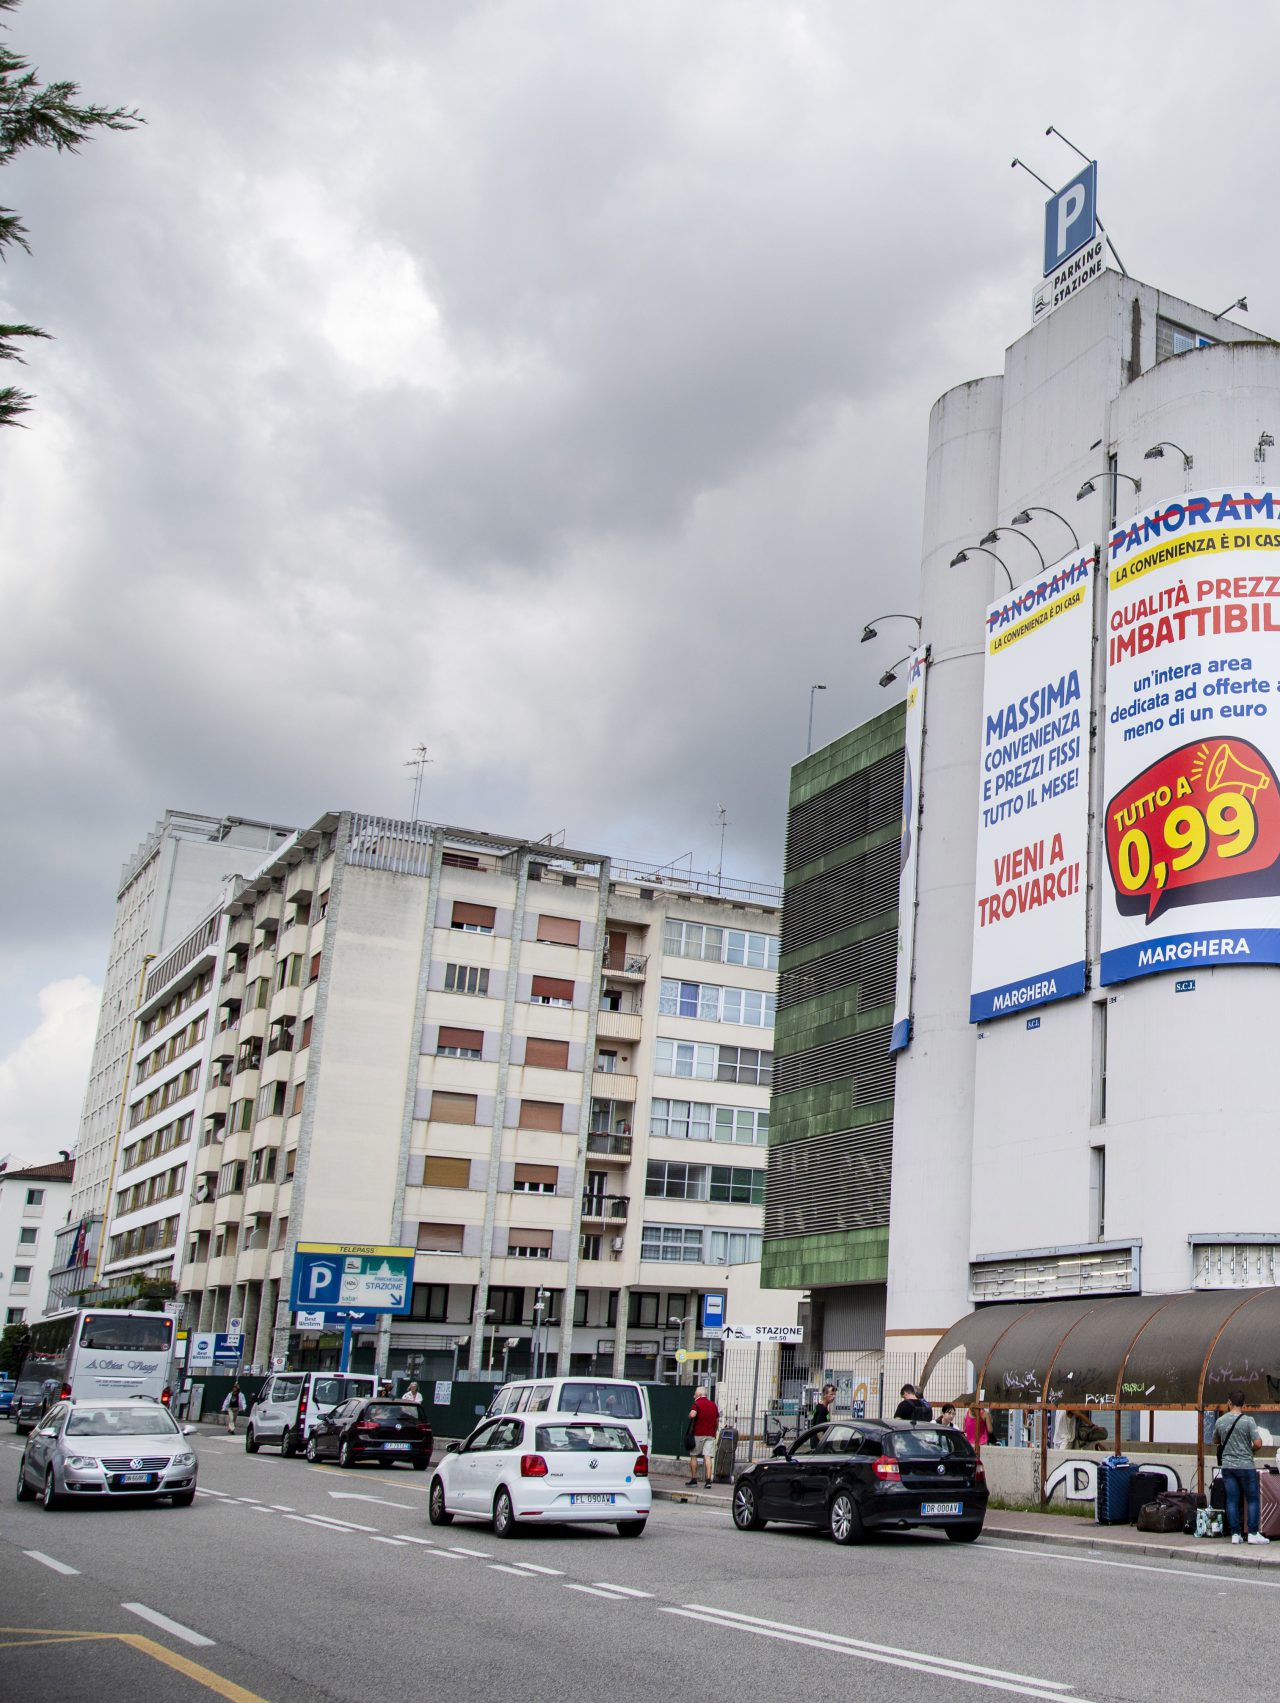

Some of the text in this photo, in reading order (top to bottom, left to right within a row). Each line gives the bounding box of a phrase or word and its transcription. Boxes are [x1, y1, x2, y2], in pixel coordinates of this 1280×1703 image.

[1056, 183, 1086, 258] P
[1053, 241, 1103, 290] PARKING
[1053, 259, 1102, 307] STAZIONE
[1116, 567, 1128, 583] LA
[1130, 537, 1216, 575] CONVENIENZA
[1220, 533, 1230, 549] È
[1234, 535, 1250, 548] DI
[989, 557, 1089, 633] PANORAMA
[1110, 579, 1190, 632] QUALITÀ
[994, 592, 1080, 650] LA CONVENIENZA È DI CASA
[1110, 692, 1170, 724] dedicata
[1174, 681, 1197, 703] ad
[1202, 677, 1270, 697] offerte
[1133, 657, 1252, 693] un'intera area
[986, 669, 1081, 746] MASSIMA
[1123, 703, 1268, 742] meno di un euro
[984, 708, 1081, 773] CONVENIENZA
[983, 735, 1080, 802] E PREZZI FISSI
[982, 767, 1079, 828] TUTTO IL MESE!
[1113, 776, 1193, 833] TUTTO A
[993, 832, 1065, 886] VIENI A
[1117, 791, 1257, 892] 0,99
[978, 862, 1080, 928] TROVARCI!
[1137, 937, 1251, 968] MARGHERA
[992, 979, 1057, 1011] MARGHERA
[339, 1246, 375, 1254] TELEPASS
[308, 1266, 333, 1299] P
[364, 1282, 404, 1291] STAZIONE
[755, 1326, 803, 1335] STAZIONE
